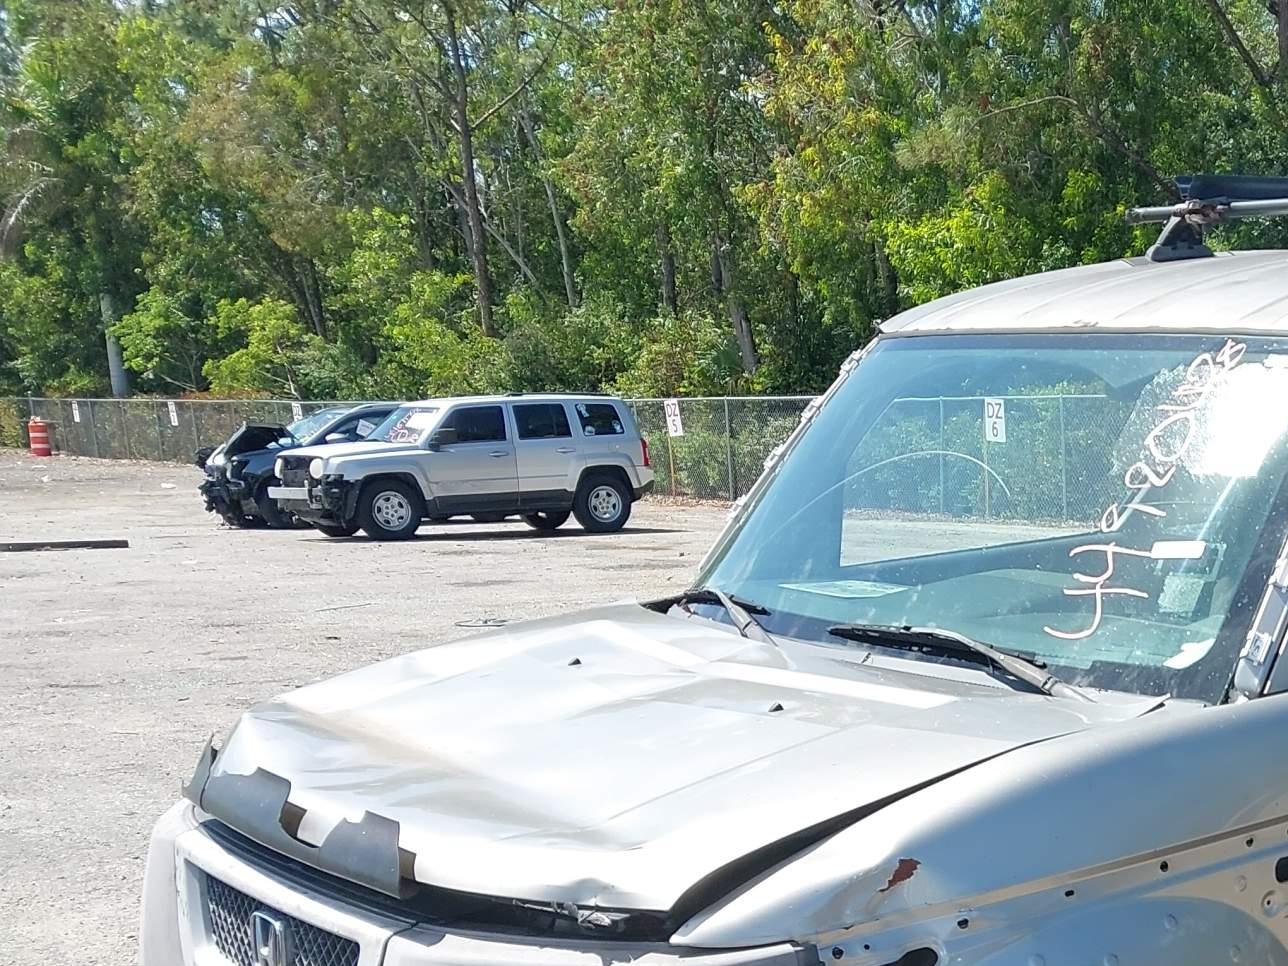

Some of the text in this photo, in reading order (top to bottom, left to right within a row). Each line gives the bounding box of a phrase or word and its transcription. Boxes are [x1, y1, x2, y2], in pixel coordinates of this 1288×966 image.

[666, 402, 678, 417] DZ
[986, 402, 1003, 419] DZ
[991, 421, 999, 437] 6
